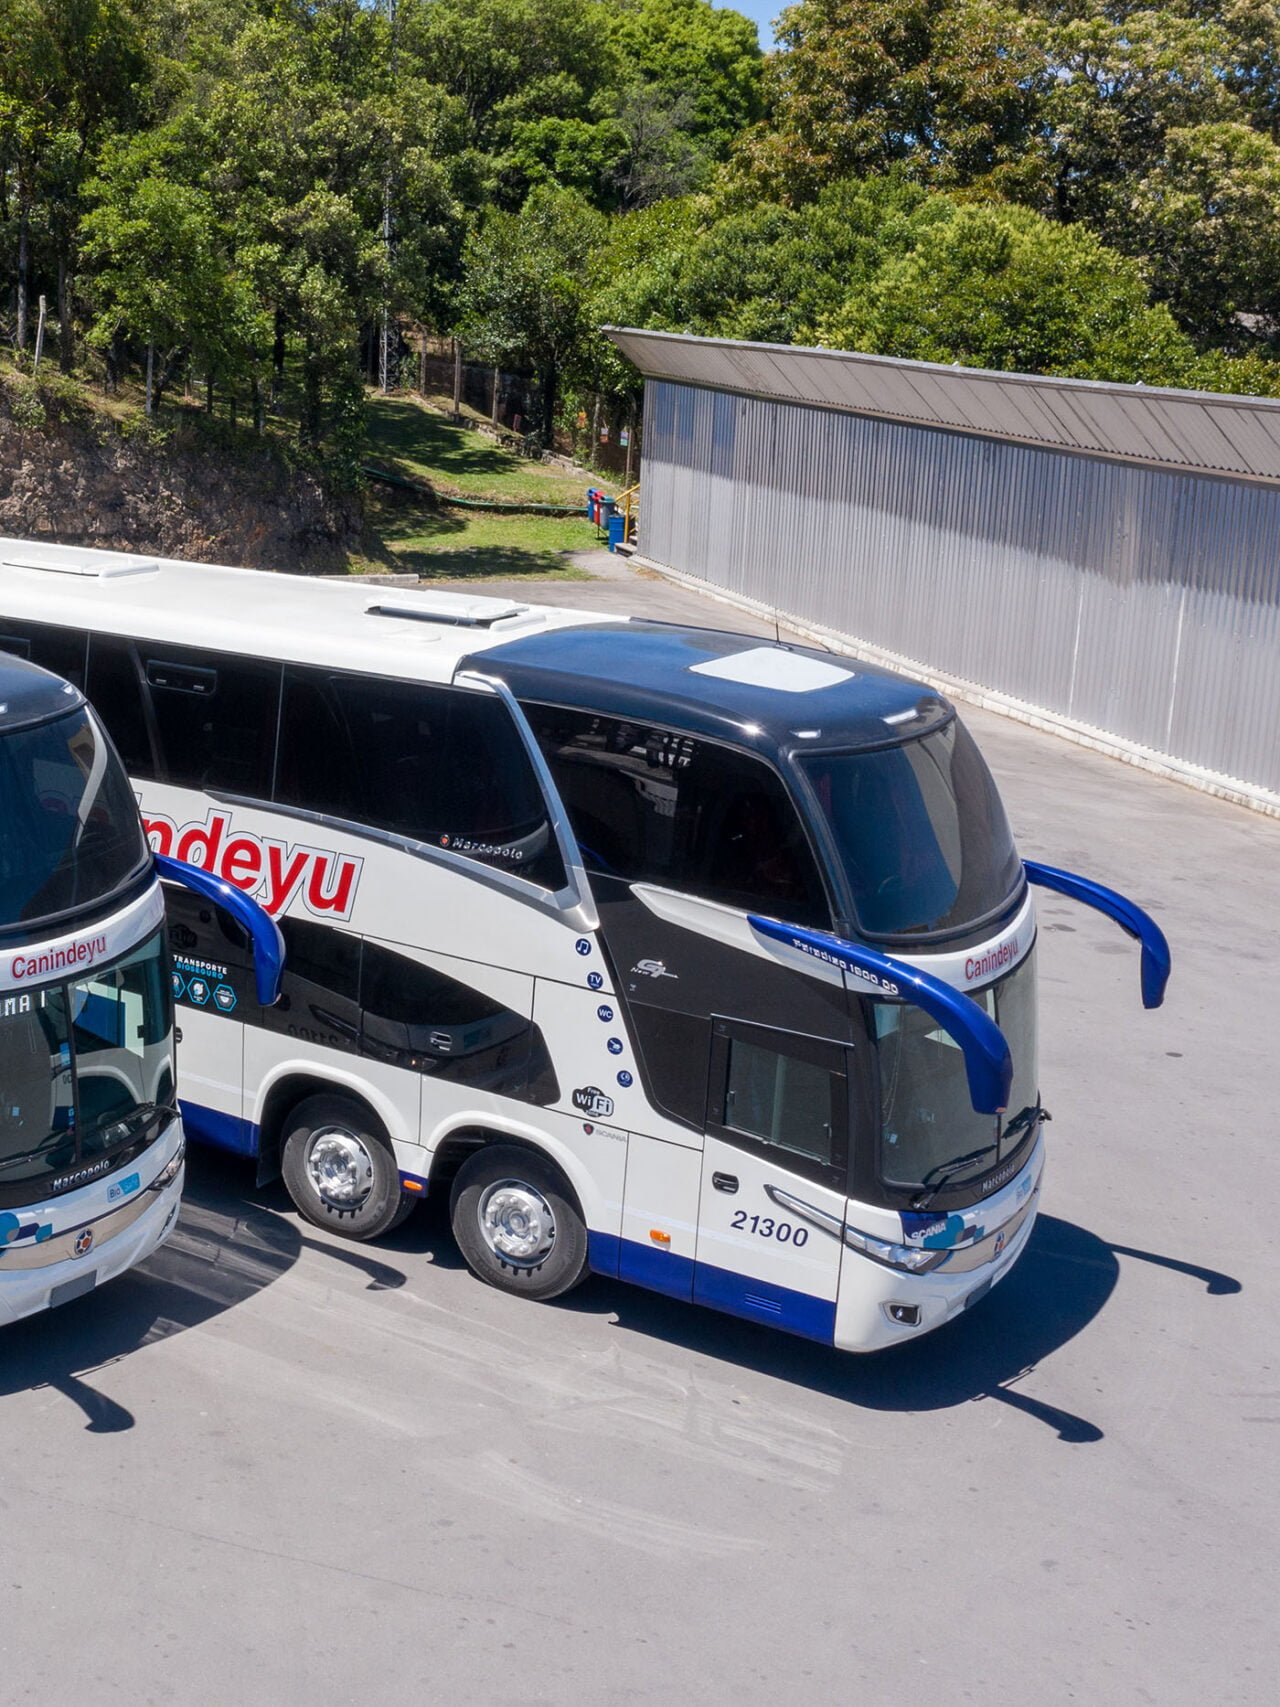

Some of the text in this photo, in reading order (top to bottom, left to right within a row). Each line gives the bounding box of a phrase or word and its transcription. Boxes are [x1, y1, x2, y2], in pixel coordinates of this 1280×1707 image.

[452, 837, 523, 860] Marcopolo
[143, 816, 356, 916] ndeyu
[11, 935, 107, 979] Canindeyu
[173, 954, 228, 975] TRANSPORTE
[176, 962, 224, 980] BIOSEGURO
[793, 938, 847, 970] Paradiso
[849, 963, 879, 985] 1800
[965, 937, 1019, 980] Canindeyu
[589, 974, 602, 984] TV
[599, 1008, 613, 1019] WC
[52, 1160, 110, 1191] Marcopolo
[982, 1163, 1015, 1193] Marcopolo
[729, 1210, 809, 1247] 21300
[910, 1221, 947, 1240] SCANIA
